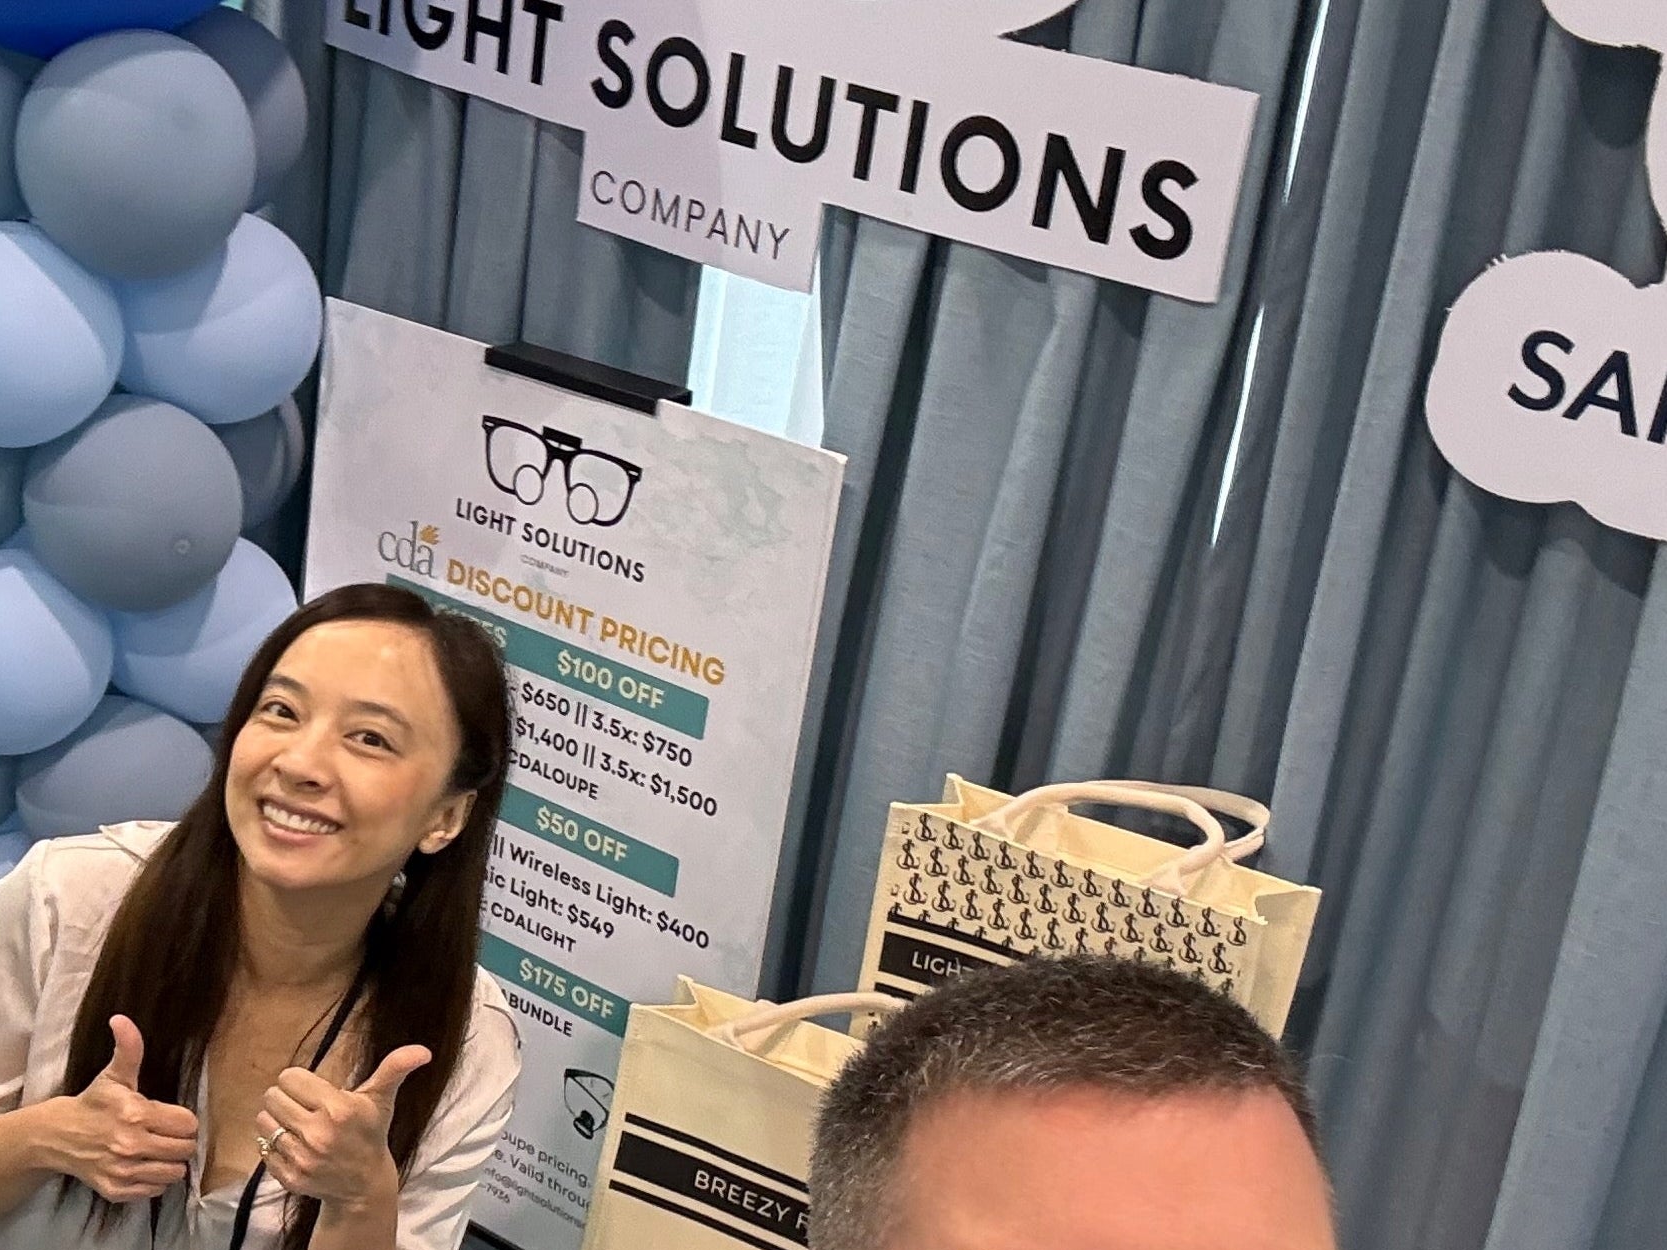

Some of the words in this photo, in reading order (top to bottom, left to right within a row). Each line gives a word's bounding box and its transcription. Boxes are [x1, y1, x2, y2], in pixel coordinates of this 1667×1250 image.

[589, 20, 1199, 261] SOLUTIONS
[590, 170, 793, 261] COMPANY
[455, 497, 517, 536] LIGHT
[520, 522, 646, 584] SOLUTIONS
[377, 519, 436, 579] cda
[446, 557, 595, 636] DISCOUNT
[599, 615, 726, 686] PRICING
[556, 649, 614, 691] $100
[617, 675, 665, 709] OFF
[521, 680, 571, 717] $650
[591, 710, 639, 746] 3.5x:
[641, 730, 693, 768] $750
[515, 715, 579, 758] $1,400
[599, 752, 646, 788] 3.5x:
[649, 772, 718, 817] $1,500
[536, 805, 580, 843] $50
[583, 828, 629, 863] OFF
[490, 901, 578, 954] CDALIGHT
[509, 842, 591, 897] Wireless
[595, 883, 654, 926] Light:
[656, 909, 711, 950] $400
[509, 876, 565, 918] Light:
[566, 902, 616, 940] $549
[519, 956, 568, 999] $175
[571, 985, 616, 1020] OFF
[510, 1153, 545, 1184] Valid
[693, 1169, 792, 1223] BREEZY
